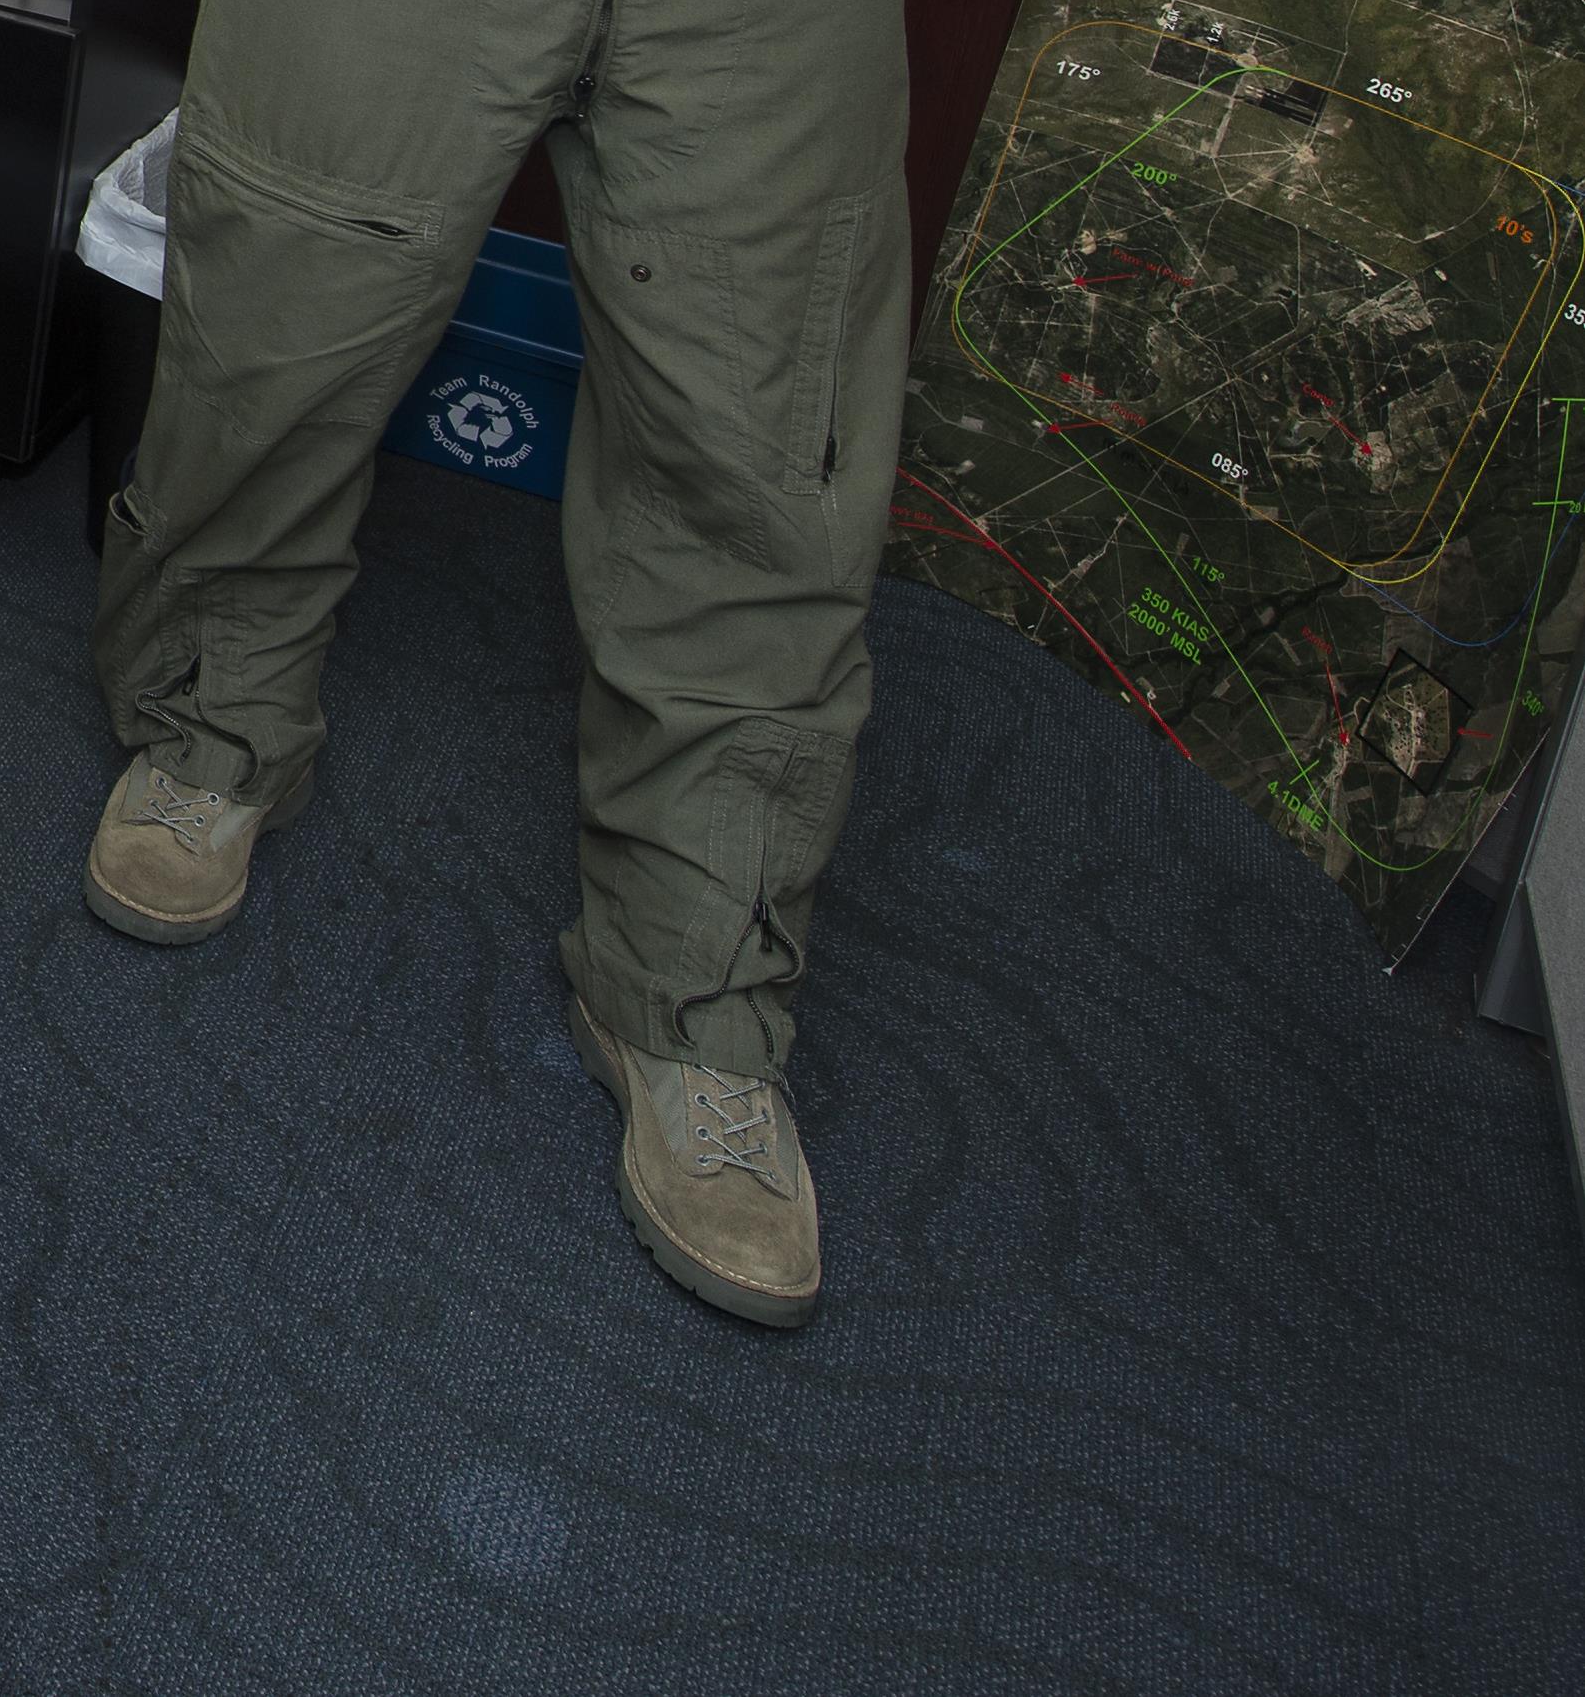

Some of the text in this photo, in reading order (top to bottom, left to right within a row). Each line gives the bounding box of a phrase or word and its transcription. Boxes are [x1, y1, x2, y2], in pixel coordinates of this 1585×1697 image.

[1056, 60, 1101, 80] 175°
[1366, 78, 1412, 102] 265°
[1131, 162, 1177, 186] 200°
[1564, 303, 1585, 329] 35
[429, 374, 540, 429] Team Randolph
[426, 414, 533, 469] Recycling Program
[1211, 452, 1249, 479] 085°
[1192, 557, 1226, 582] 115°
[1141, 586, 1210, 642] 350 KIAS
[1170, 632, 1202, 665] MSL
